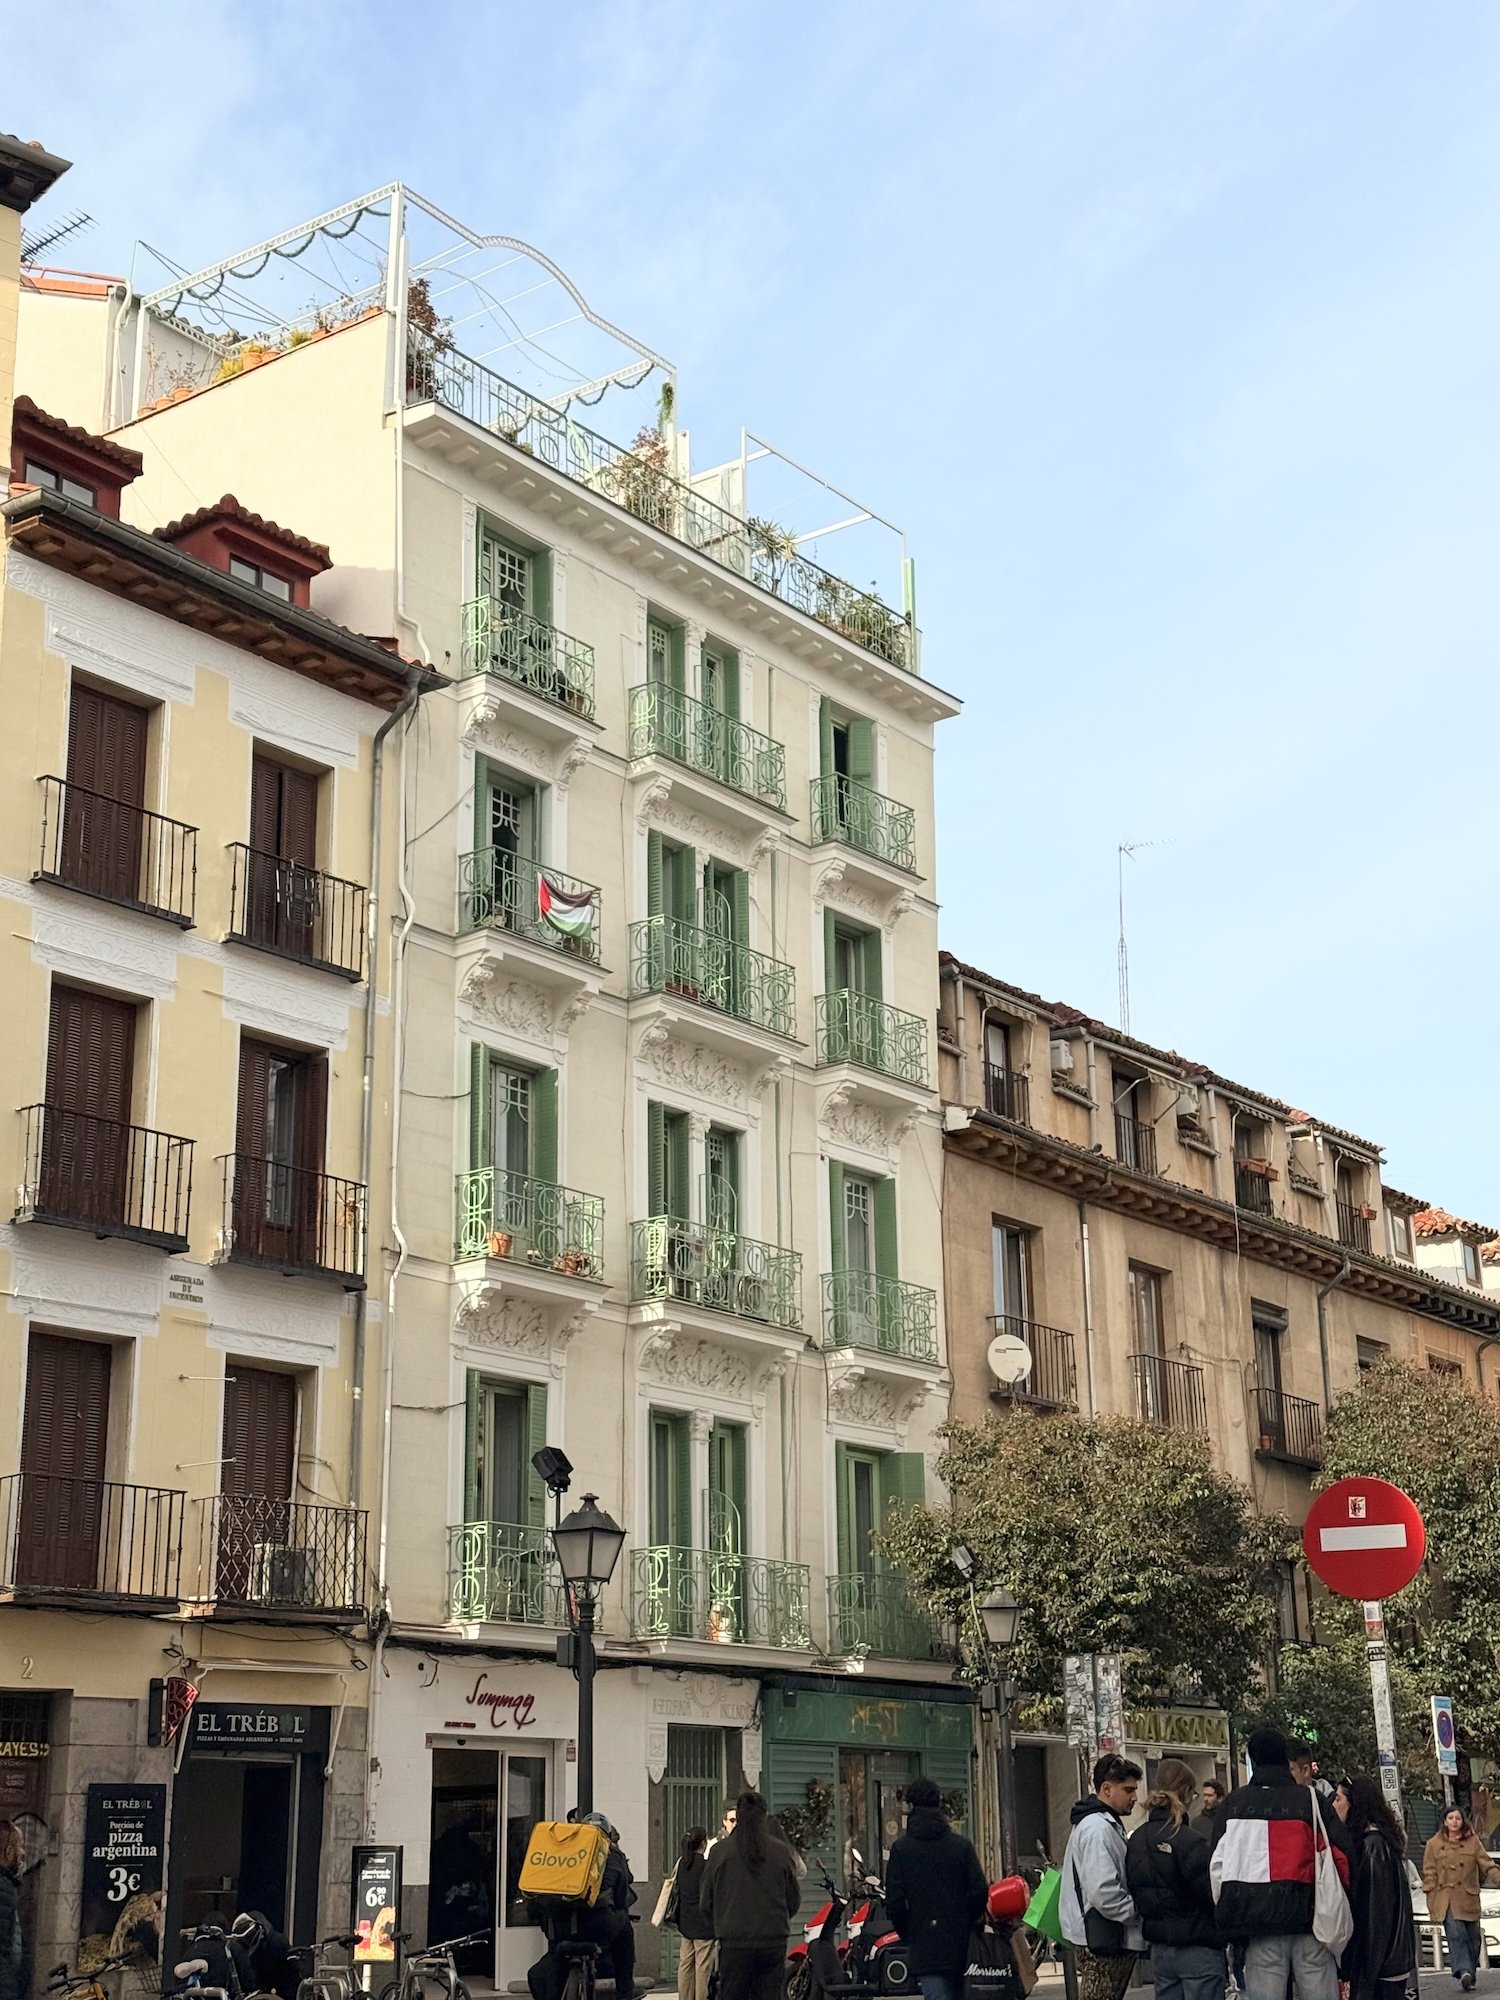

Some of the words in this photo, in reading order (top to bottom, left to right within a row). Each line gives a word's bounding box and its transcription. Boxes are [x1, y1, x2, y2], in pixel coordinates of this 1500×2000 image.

[182, 1284, 192, 1293] DE
[21, 1656, 34, 1679] 2
[197, 1713, 222, 1732] EL
[102, 1800, 114, 1809] EL
[1232, 1805, 1304, 1816] TOMMY
[109, 1821, 135, 1829] Porción
[135, 1821, 144, 1829] de
[108, 1829, 143, 1846] pizza
[92, 1842, 157, 1860] argentina
[530, 1851, 577, 1868] Glovo
[107, 1867, 141, 1902] 3€
